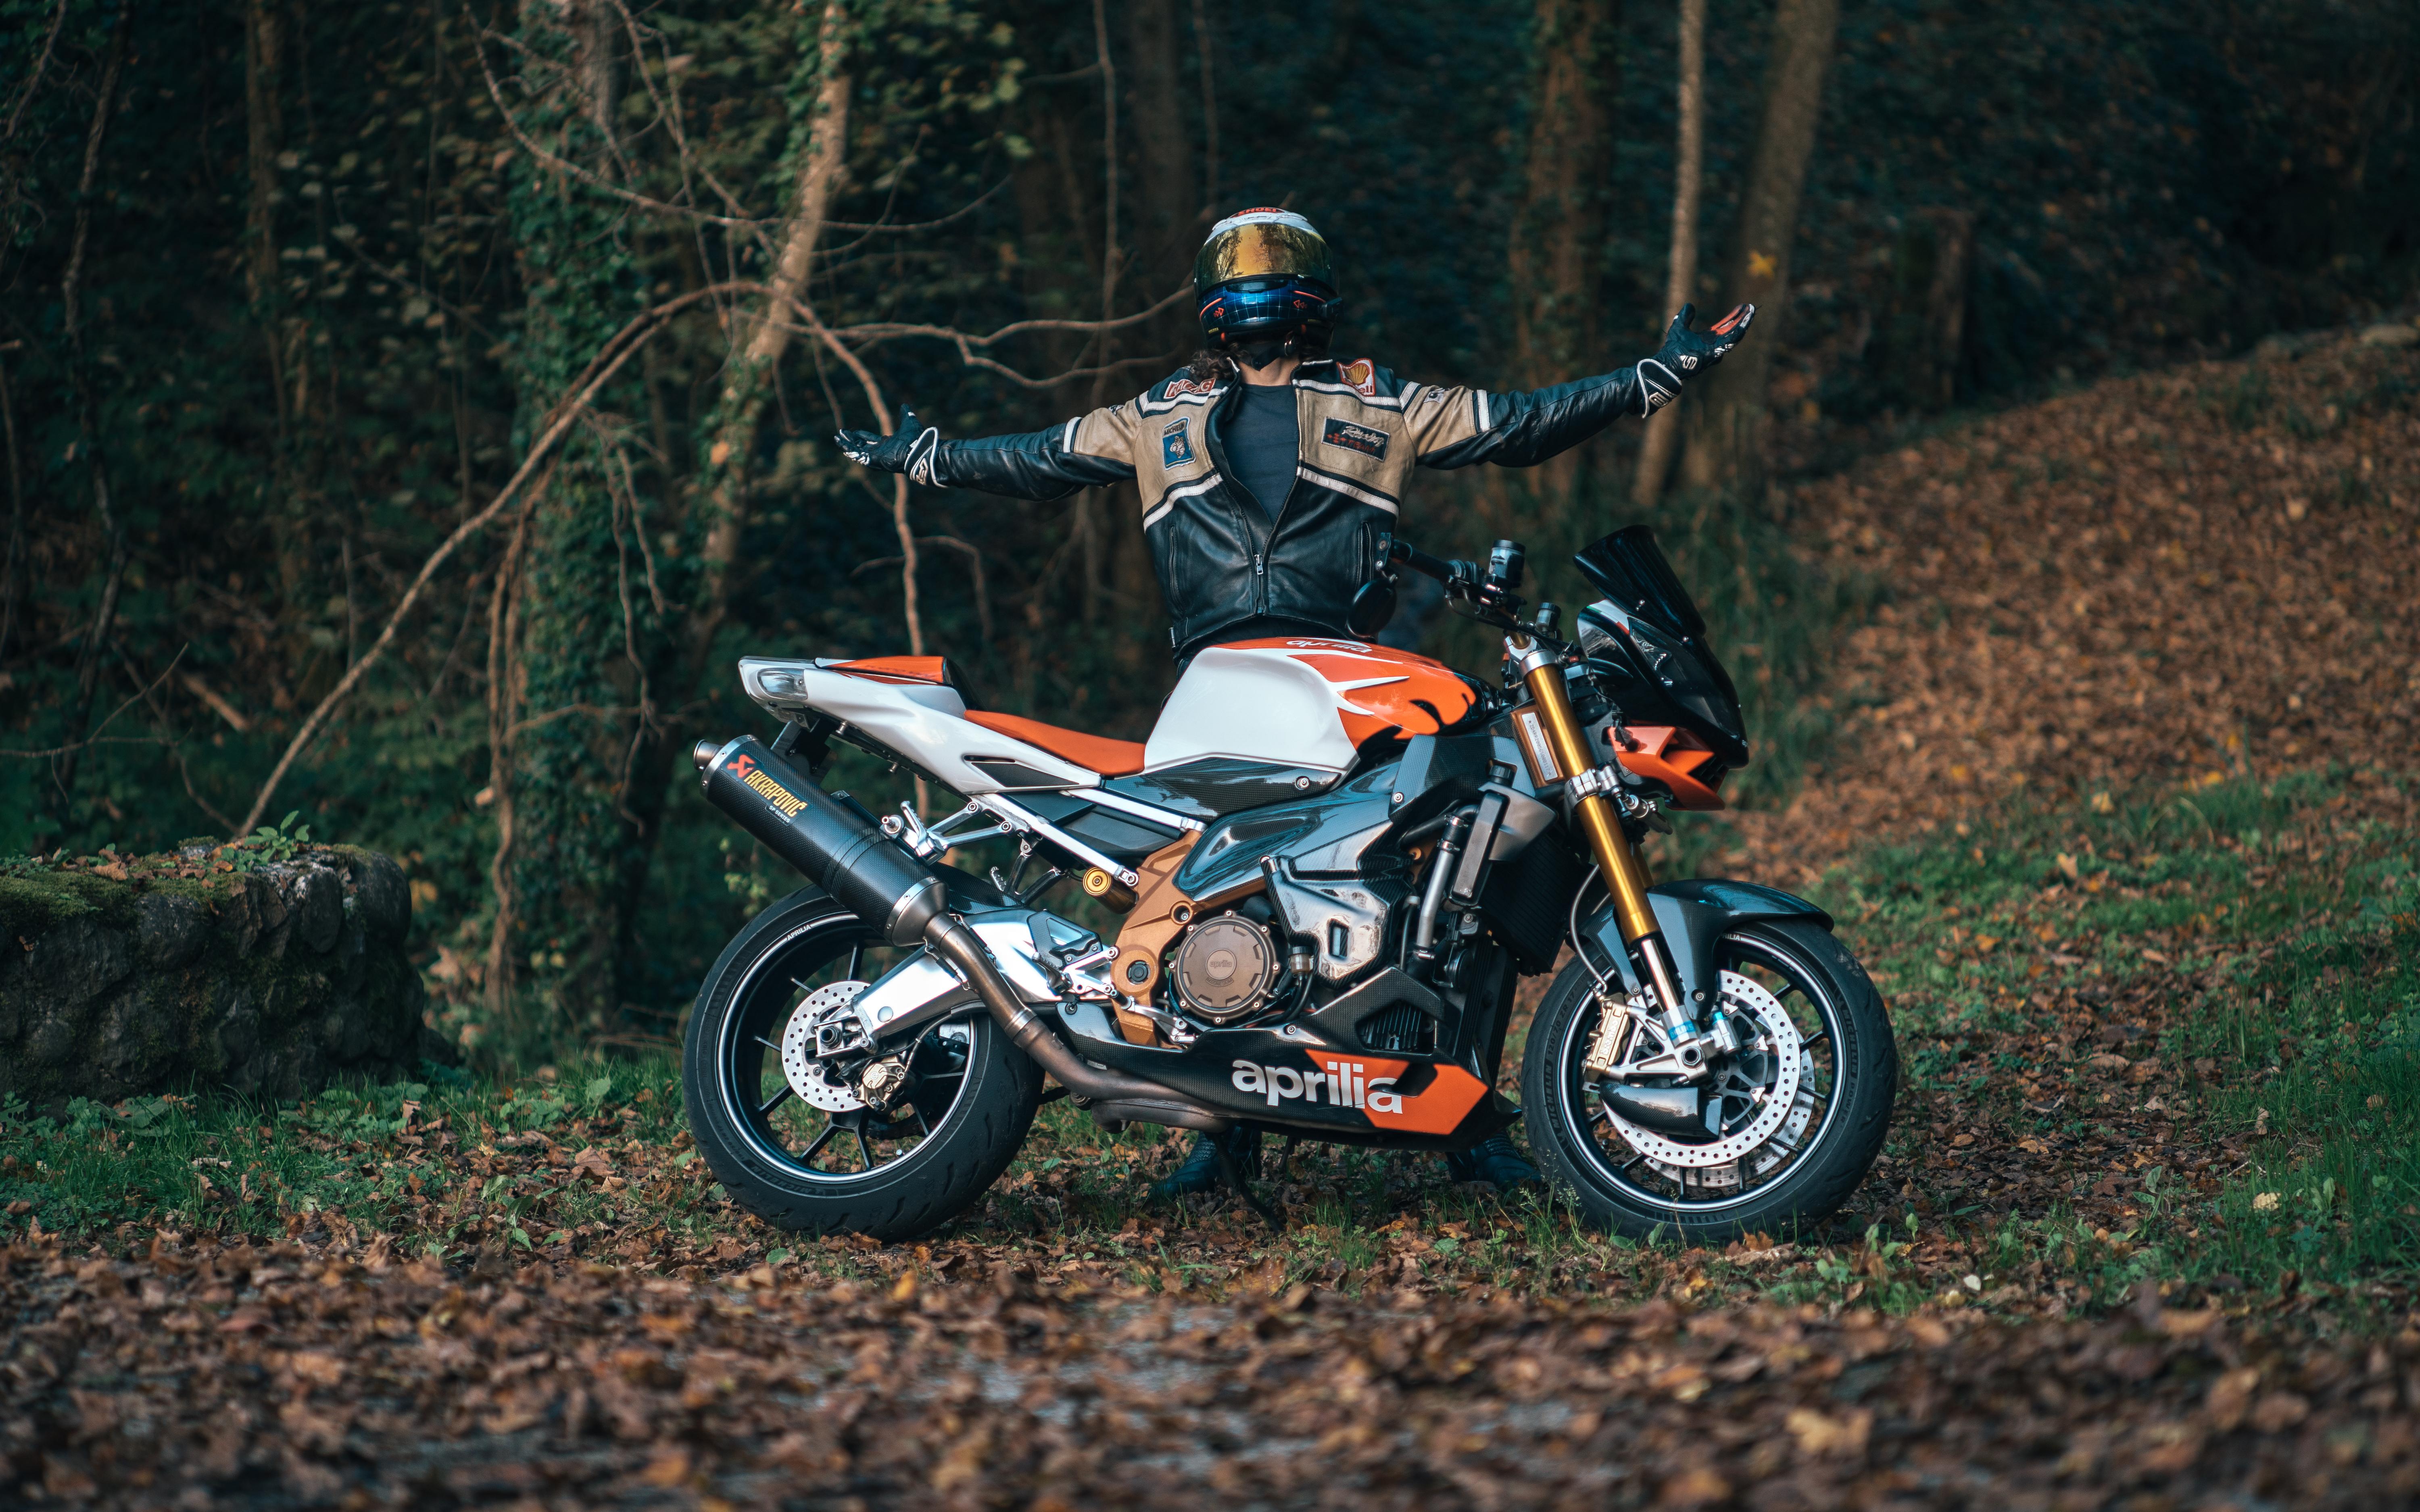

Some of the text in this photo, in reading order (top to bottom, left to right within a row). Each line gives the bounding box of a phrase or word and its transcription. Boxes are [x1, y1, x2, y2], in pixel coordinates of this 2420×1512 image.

[1164, 421, 1185, 435] MICHELIN
[1341, 425, 1385, 447] Racing
[1348, 439, 1375, 452] TEAM
[1286, 640, 1373, 653] aprilia
[743, 769, 808, 817] AKRAPOVIČ
[775, 810, 791, 823] SERIES
[787, 925, 812, 941] APRILIA
[1209, 960, 1232, 968] aprilia
[1600, 1020, 1619, 1055] brembo
[1545, 991, 1575, 1129] MICHELIN 120/70 ZR 17
[1840, 1009, 1857, 1123] MICHELIN POWER
[1232, 1059, 1404, 1114] aprilia
[750, 1166, 812, 1194] MICHELIN
